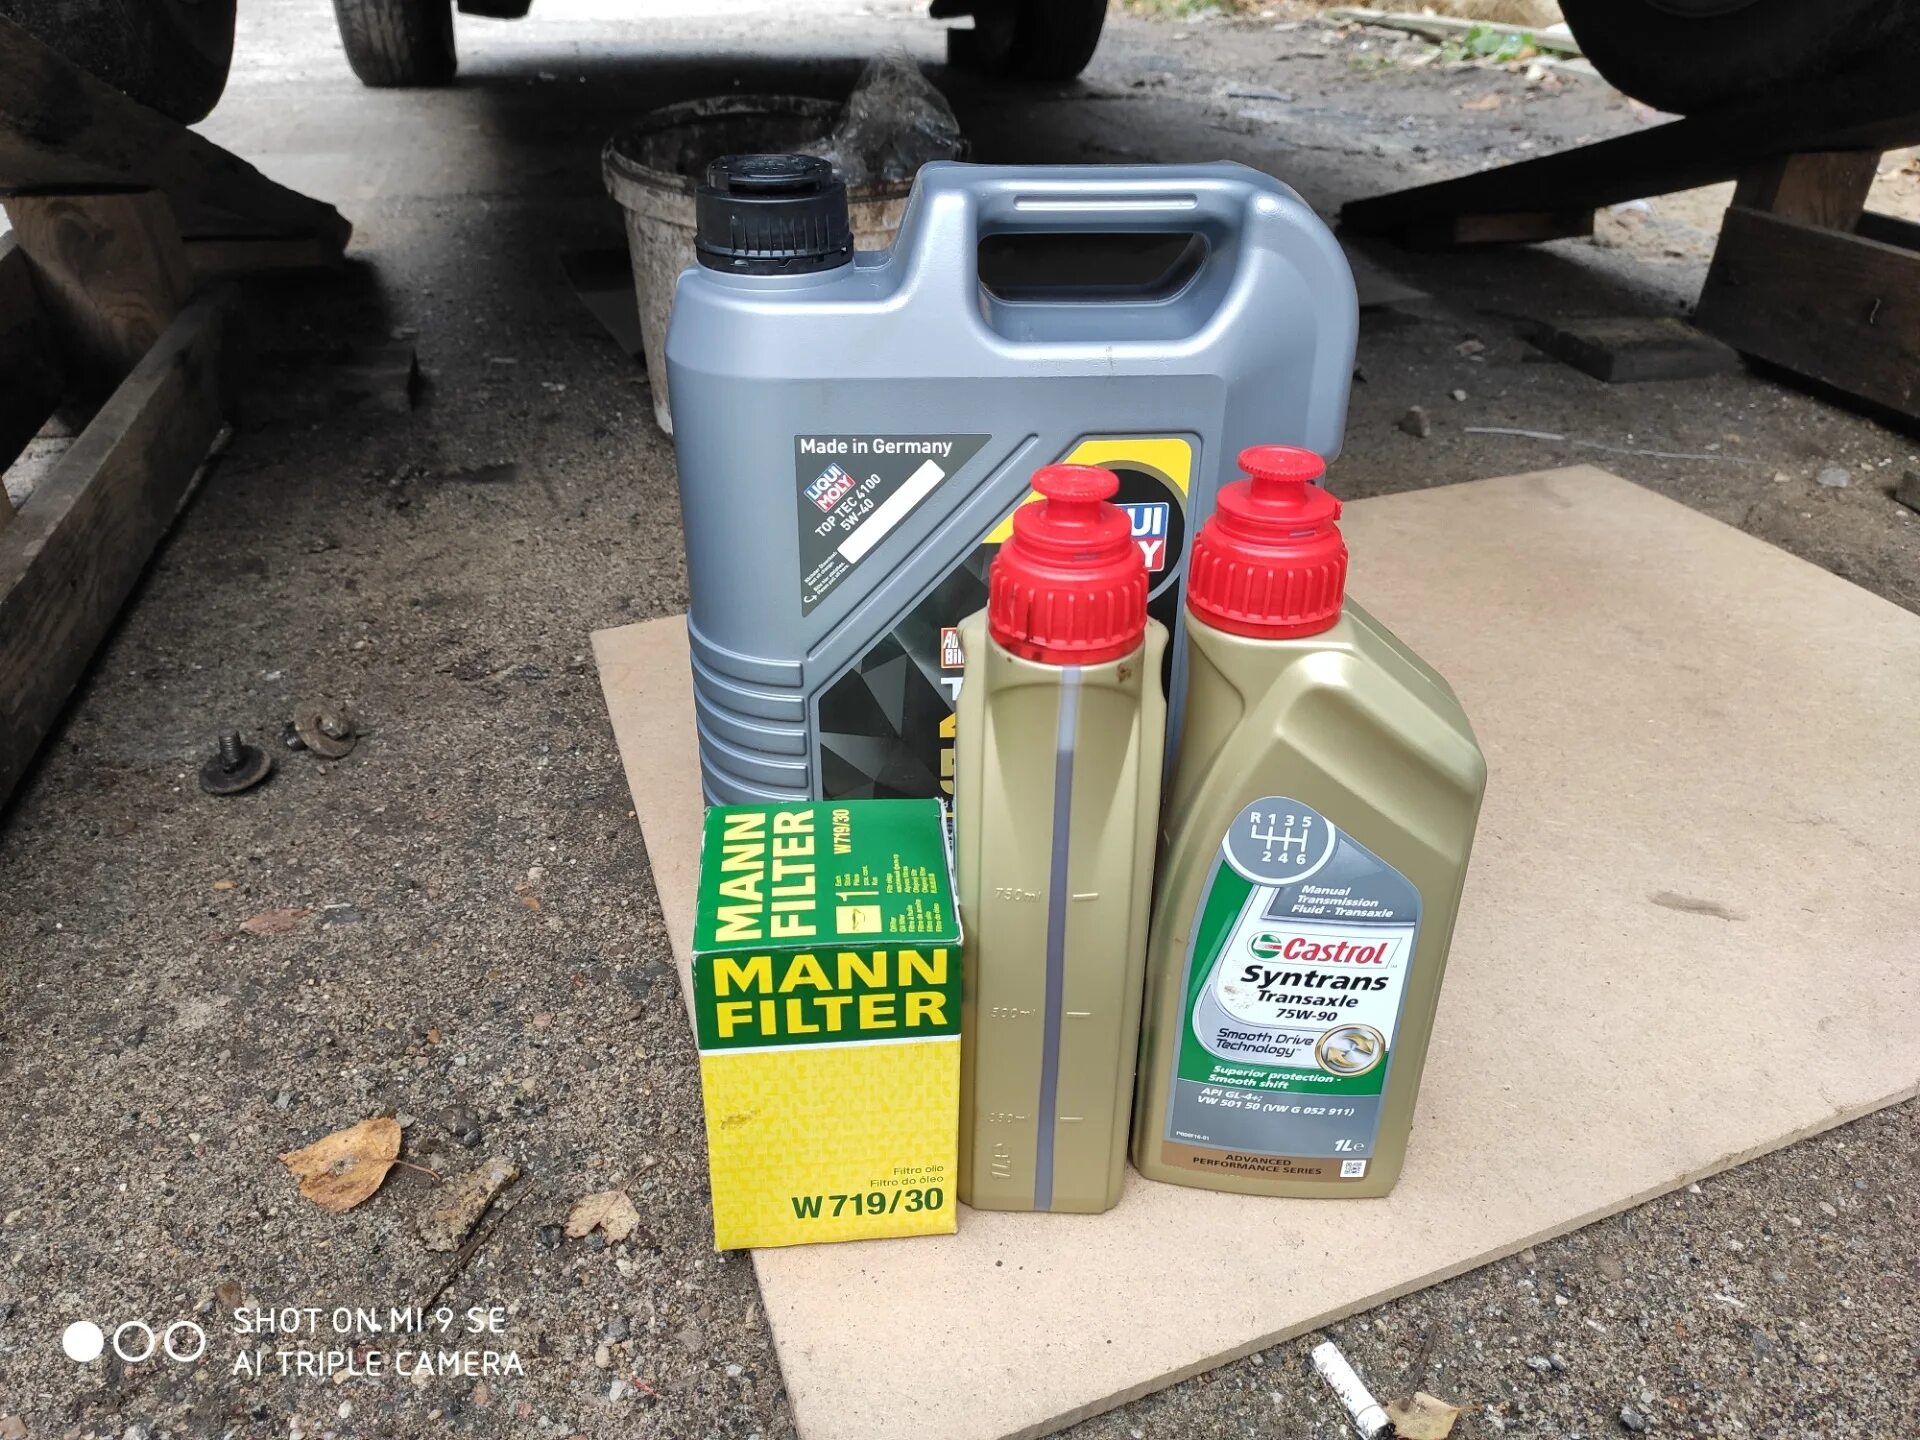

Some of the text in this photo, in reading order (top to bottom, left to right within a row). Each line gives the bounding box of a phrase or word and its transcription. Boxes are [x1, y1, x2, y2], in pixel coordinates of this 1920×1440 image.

[800, 438, 952, 457] Made in Germany
[806, 465, 842, 500] LIQUI
[817, 475, 852, 510] MOLY
[814, 473, 881, 537] TOP TEC 4100
[840, 498, 874, 532] 5W-40
[1250, 812, 1312, 827] R 1 3 5
[1261, 851, 1306, 865] 2 4 6
[715, 812, 766, 942] MANN
[770, 809, 817, 938] FILTER
[1301, 885, 1351, 896] Manual
[1297, 895, 1379, 907] Transmission
[1291, 904, 1325, 914] Fluid
[1334, 907, 1394, 918] Transaxle
[1283, 937, 1388, 964] Castrol
[713, 949, 948, 996] MANN
[1240, 965, 1389, 991] Syntrans
[1257, 990, 1359, 1008] Transaxle
[716, 991, 948, 1038] FILTER
[1275, 1008, 1338, 1022] 75W-90
[1216, 1027, 1314, 1046] Smooth Drive
[1208, 1074, 1290, 1089] Smooth shift
[1213, 1065, 1268, 1079] Superior
[1267, 1072, 1334, 1083] protection
[1201, 1087, 1223, 1096] API
[1197, 1095, 1217, 1105] VW
[1220, 1099, 1241, 1108] 501
[1244, 1102, 1260, 1110] 50
[1262, 1103, 1289, 1112] (VW
[1303, 1107, 1325, 1115] 052
[1327, 1108, 1354, 1117] 911)
[1192, 1157, 1322, 1175] PERFORMANCE SERIES
[1225, 1154, 1292, 1166] ADVANCED
[893, 1165, 944, 1175] Filtro olio
[870, 1175, 944, 1188] Filtro do óleo
[792, 1187, 944, 1219] W 719/30
